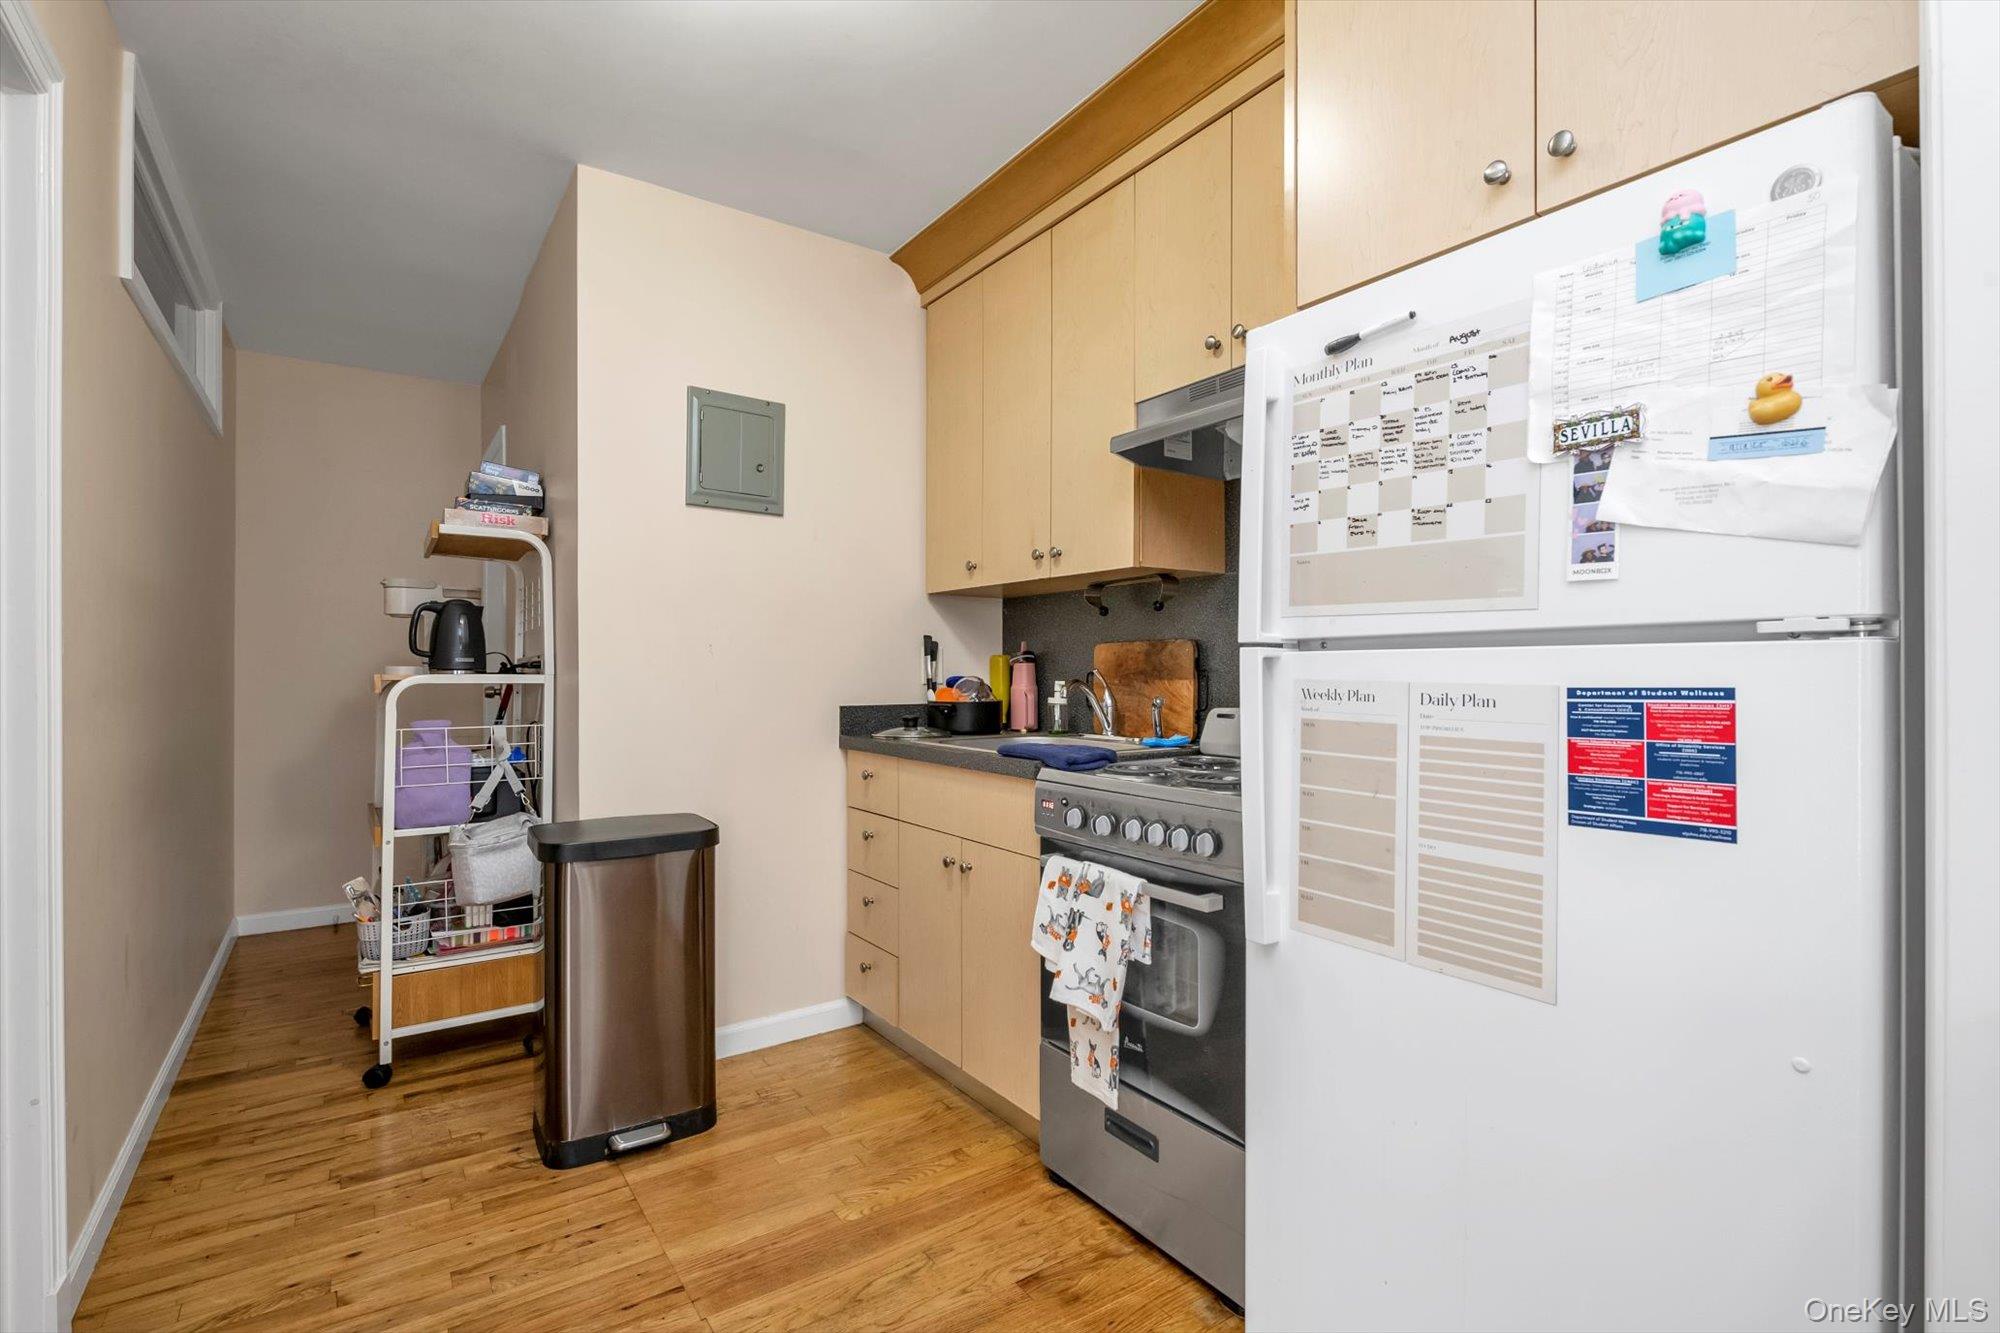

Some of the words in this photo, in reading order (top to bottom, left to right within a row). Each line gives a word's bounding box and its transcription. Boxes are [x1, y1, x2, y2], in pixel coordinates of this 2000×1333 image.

[1449, 329, 1481, 345] August
[1294, 364, 1341, 386] Monthly
[1345, 356, 1373, 373] Plan
[1560, 416, 1631, 444] SEVILLA
[481, 513, 516, 526] Risk
[1302, 688, 1345, 705] Weekly
[1348, 689, 1376, 703] Plan
[1420, 692, 1457, 712] Daily
[1461, 693, 1497, 709] Plan
[1576, 690, 1626, 698] Department
